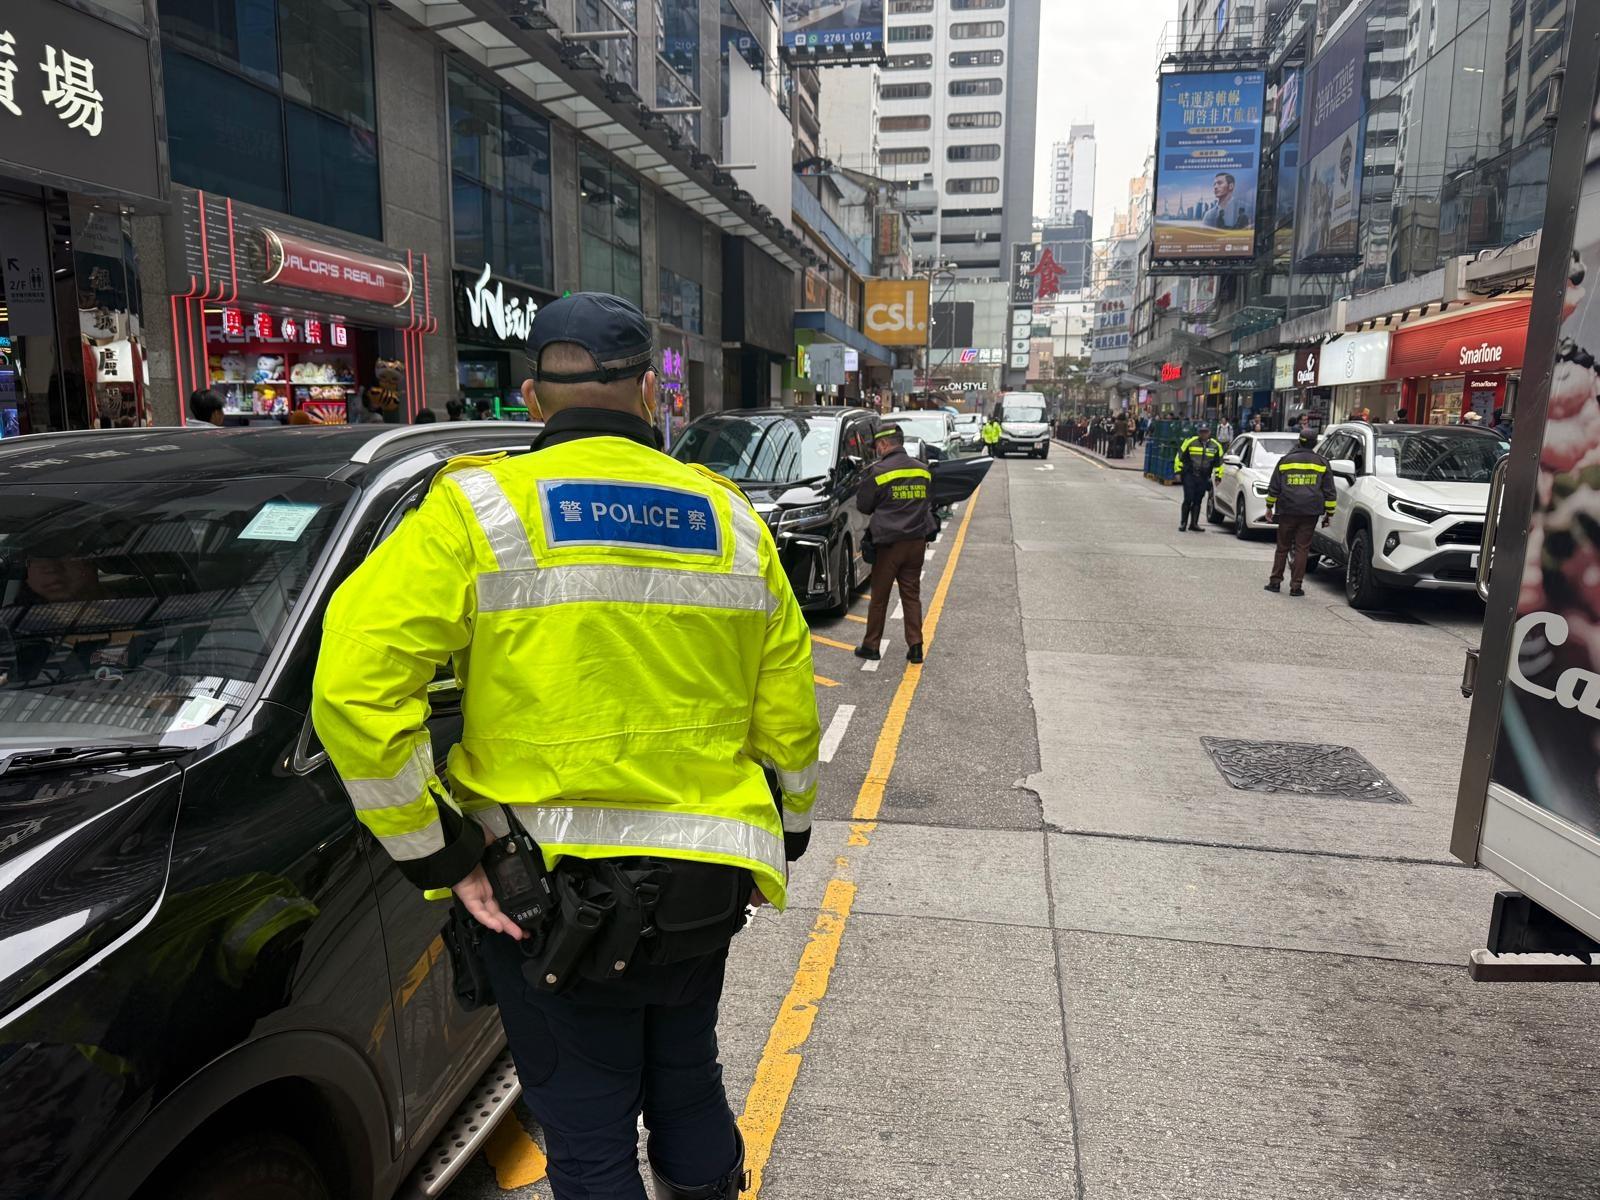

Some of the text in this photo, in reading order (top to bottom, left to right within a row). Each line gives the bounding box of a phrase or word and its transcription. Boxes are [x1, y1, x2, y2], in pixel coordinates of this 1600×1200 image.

[850, 31, 872, 41] 1012
[1318, 86, 1353, 125] FITNESS
[9, 280, 26, 290] 2/F
[343, 267, 385, 288] REALM
[1459, 342, 1503, 365] SmarTone
[962, 381, 988, 391] STYLE
[559, 500, 707, 531] 警 POLICE 察
